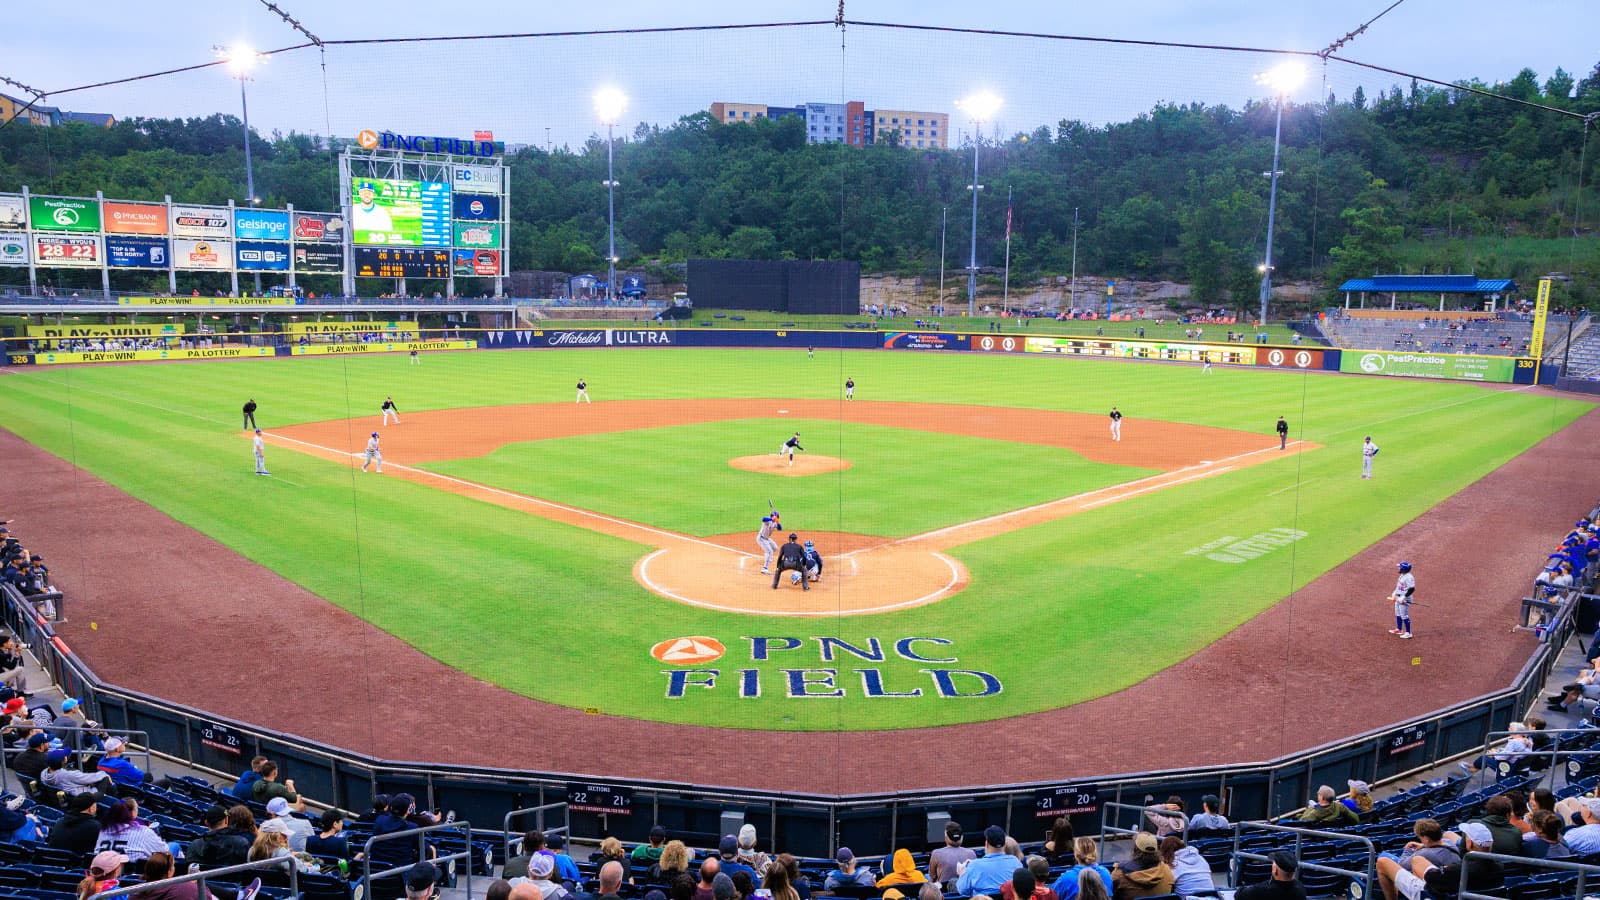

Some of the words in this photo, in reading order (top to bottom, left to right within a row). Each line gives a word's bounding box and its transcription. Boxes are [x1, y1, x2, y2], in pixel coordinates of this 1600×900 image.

[382, 133, 426, 153] PNC
[435, 137, 494, 158] FIELD
[207, 219, 226, 227] 107
[237, 218, 287, 233] Geisinger
[42, 245, 64, 256] 28
[71, 245, 92, 257] 22
[548, 330, 601, 345] Michelob
[82, 353, 105, 361] PLAY
[115, 352, 136, 360] WIN!
[202, 349, 241, 357] LOTTERY
[1387, 354, 1446, 365] PestPractice
[1518, 360, 1534, 368] 330
[740, 635, 958, 662] PNC
[660, 668, 1003, 698] FIELD
[204, 728, 213, 739] 23
[227, 735, 236, 746] 22
[1395, 736, 1404, 746] 20
[574, 792, 587, 803] 22
[613, 795, 624, 806] 21
[1042, 797, 1052, 809] 21
[1077, 793, 1090, 805] 20
